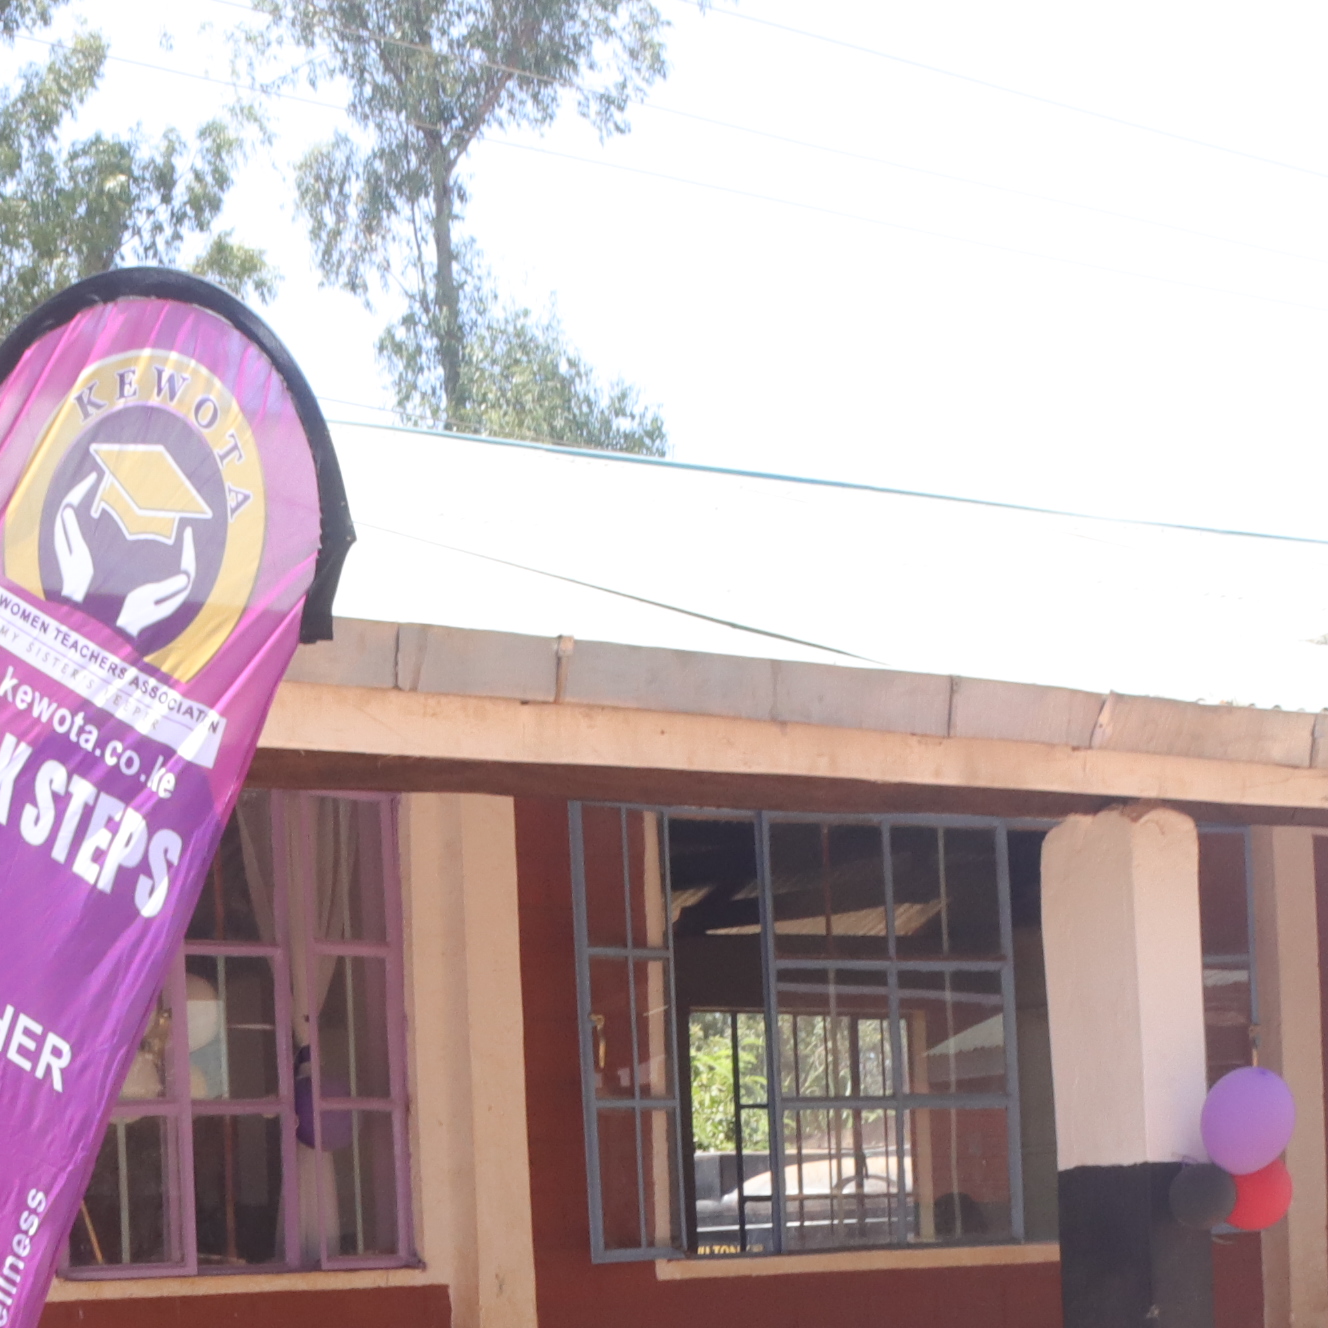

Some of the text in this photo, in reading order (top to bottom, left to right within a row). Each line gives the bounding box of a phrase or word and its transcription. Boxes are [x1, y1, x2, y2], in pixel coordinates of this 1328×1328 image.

[74, 366, 252, 522] KEWOTA
[0, 625, 20, 643] MY
[0, 593, 50, 635] WOMEN
[53, 626, 129, 680] TEACHERS
[19, 757, 183, 918] STEPS
